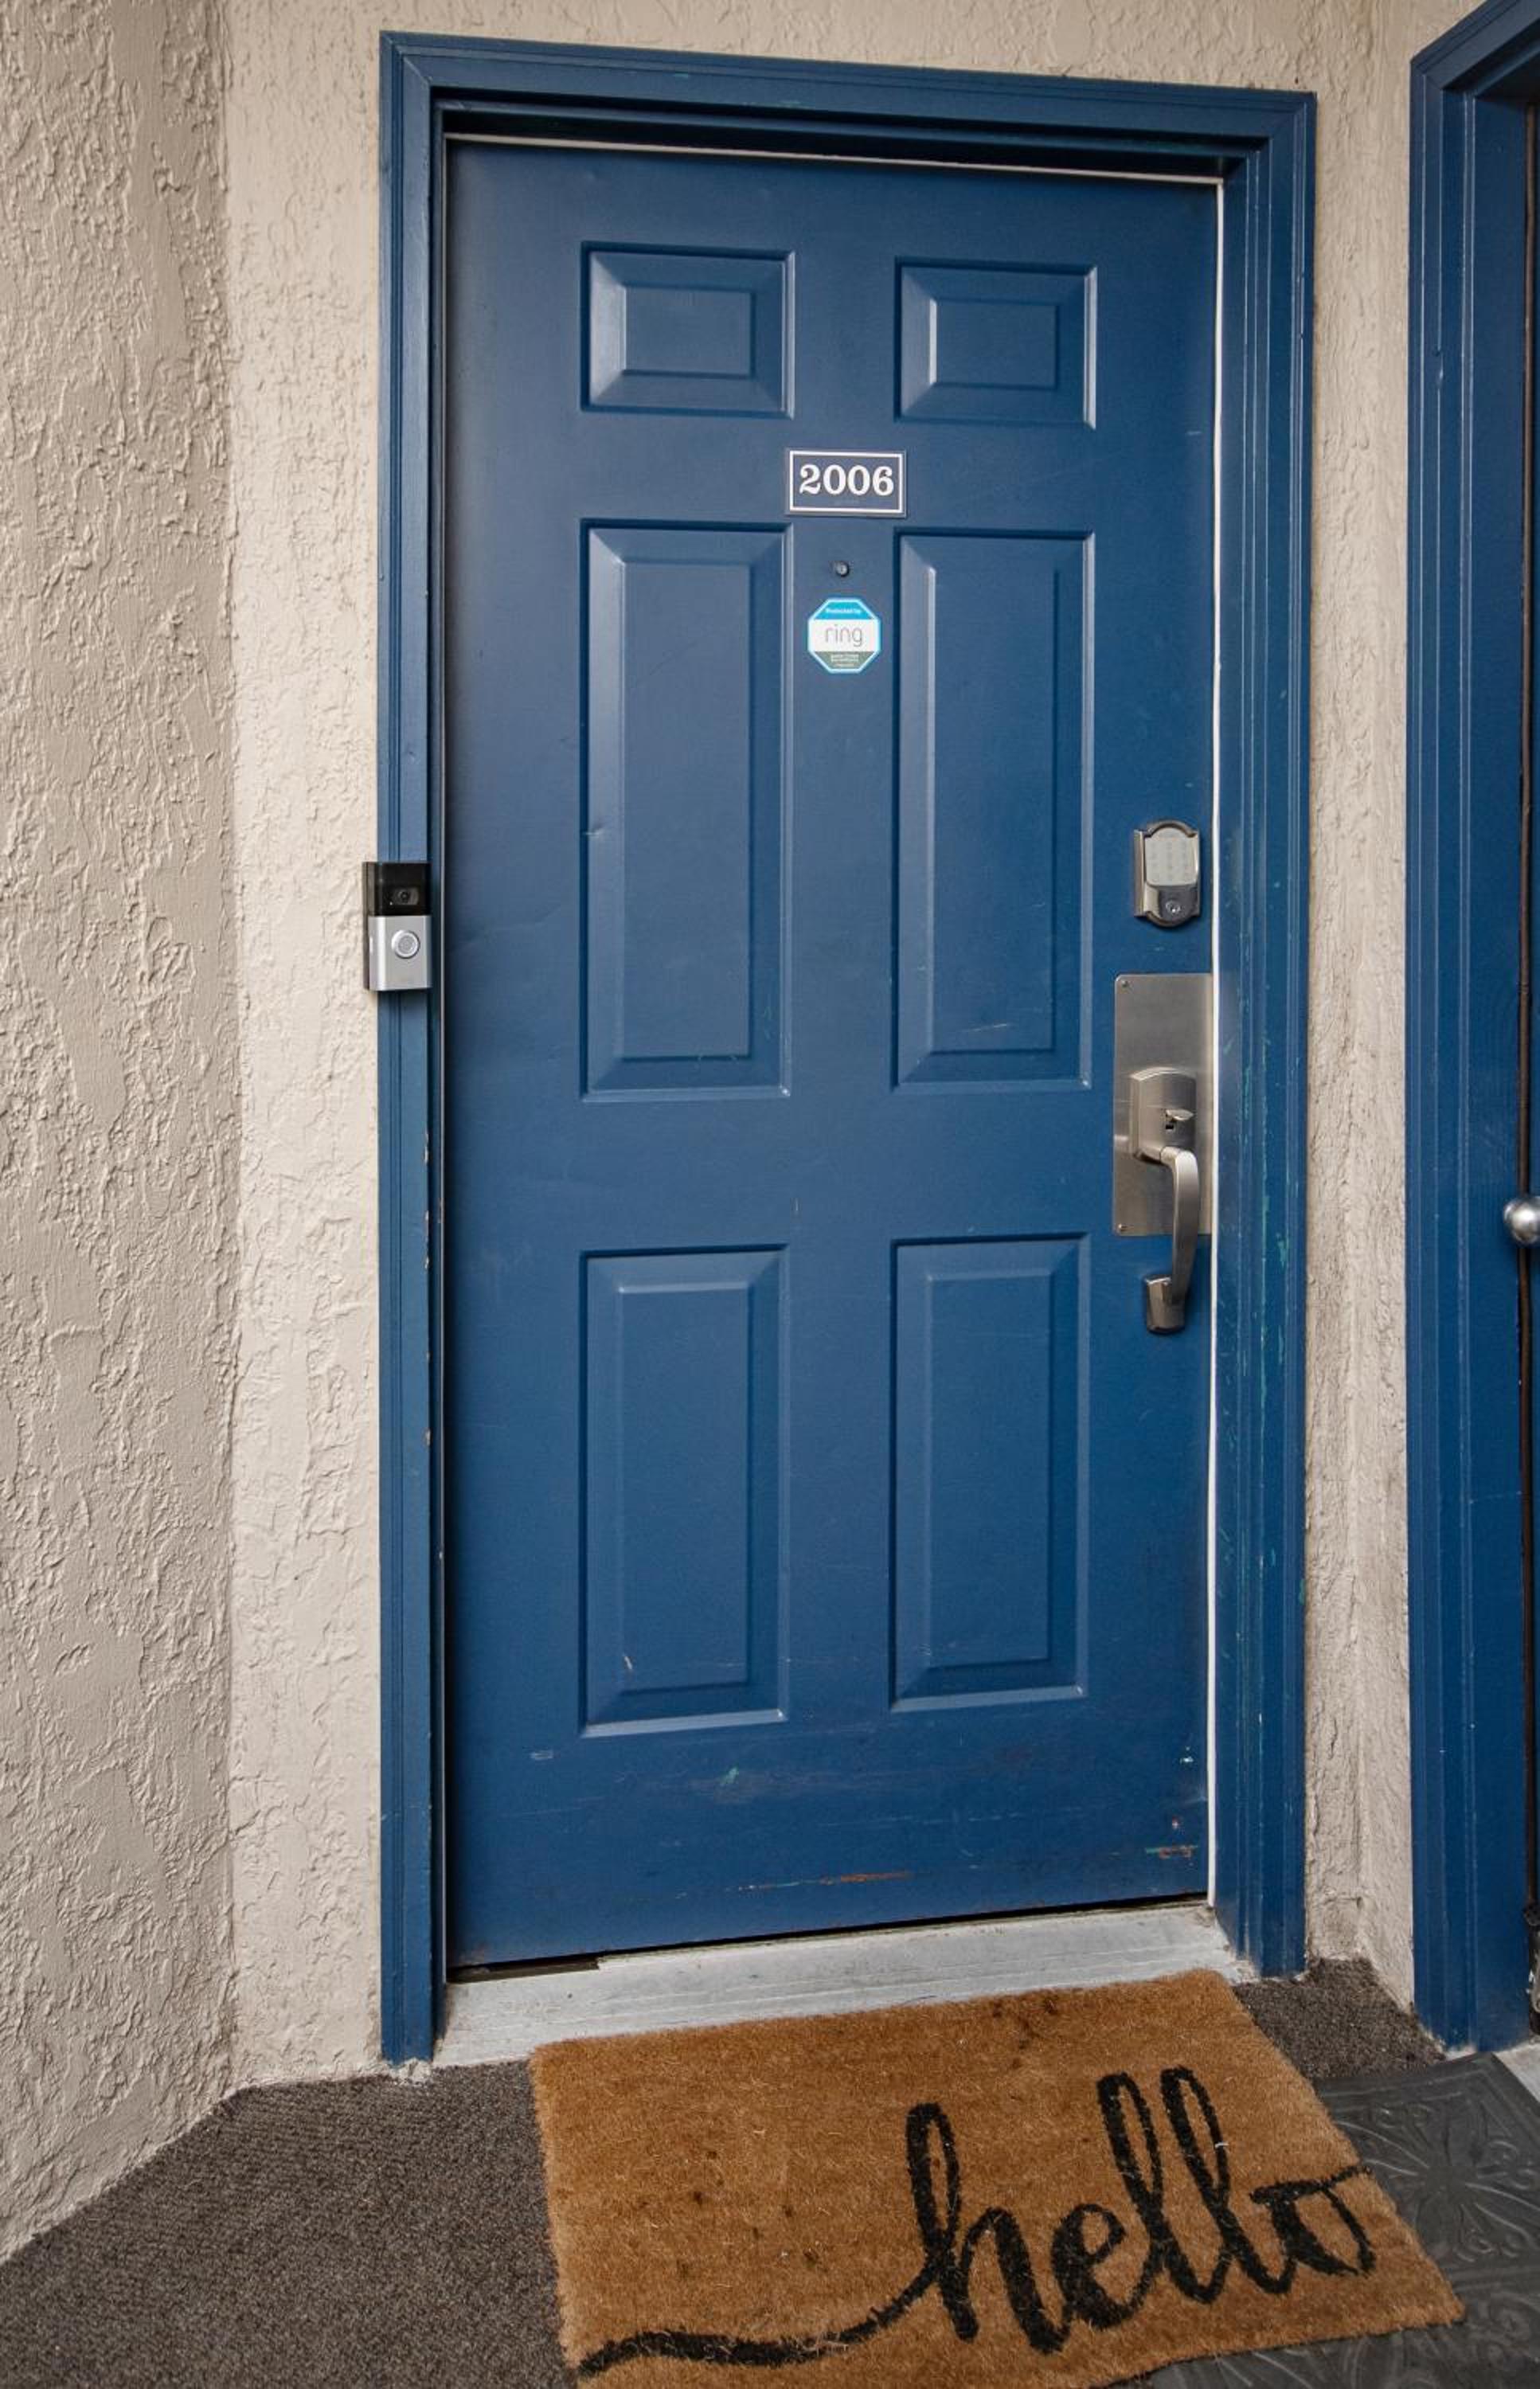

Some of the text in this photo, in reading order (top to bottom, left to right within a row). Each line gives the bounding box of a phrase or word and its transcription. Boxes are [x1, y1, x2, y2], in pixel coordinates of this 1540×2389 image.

[799, 463, 894, 495] 2006
[825, 624, 862, 647] ring
[900, 2065, 1375, 2357] hello
